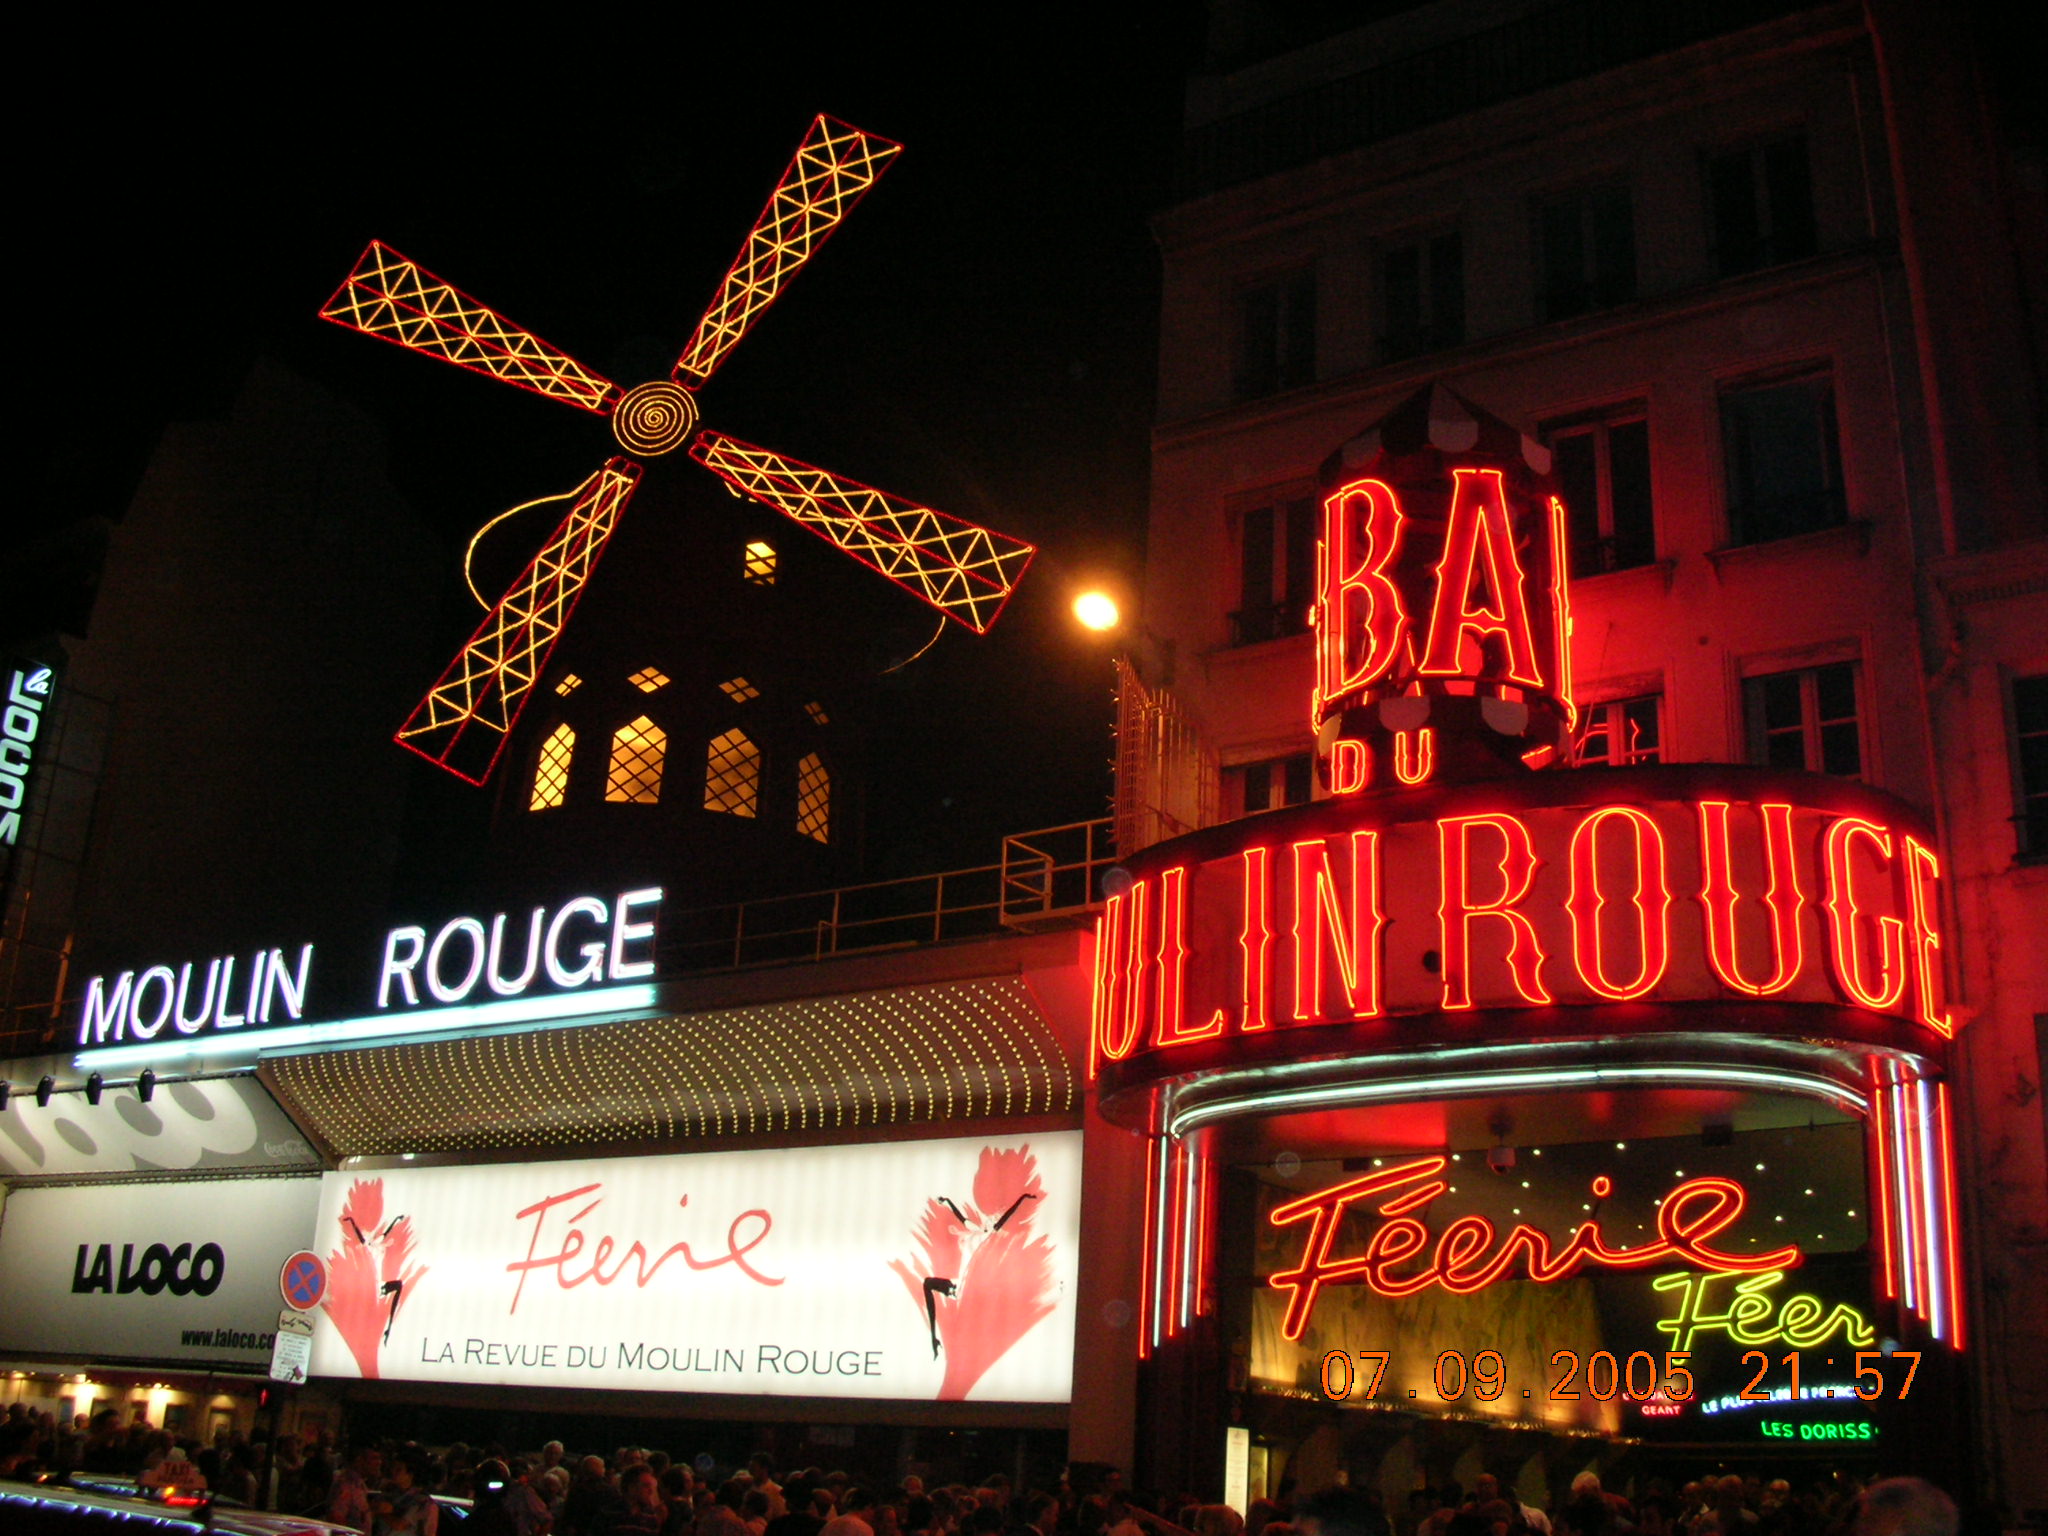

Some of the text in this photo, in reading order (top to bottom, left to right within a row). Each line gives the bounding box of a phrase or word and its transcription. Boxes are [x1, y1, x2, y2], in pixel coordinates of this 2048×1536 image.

[1331, 728, 1432, 794] DU
[79, 886, 664, 1045] MOULIN ROUGE
[1090, 803, 1953, 1081] ULIN ROUGE
[72, 1241, 225, 1297] LA LOCO
[507, 1183, 786, 1315] Féerie
[1271, 1154, 1803, 1342] Féerie
[420, 1337, 884, 1376] LA REVUE DU MOULIN ROUGE
[1761, 1421, 1871, 1440] LES DORISS
